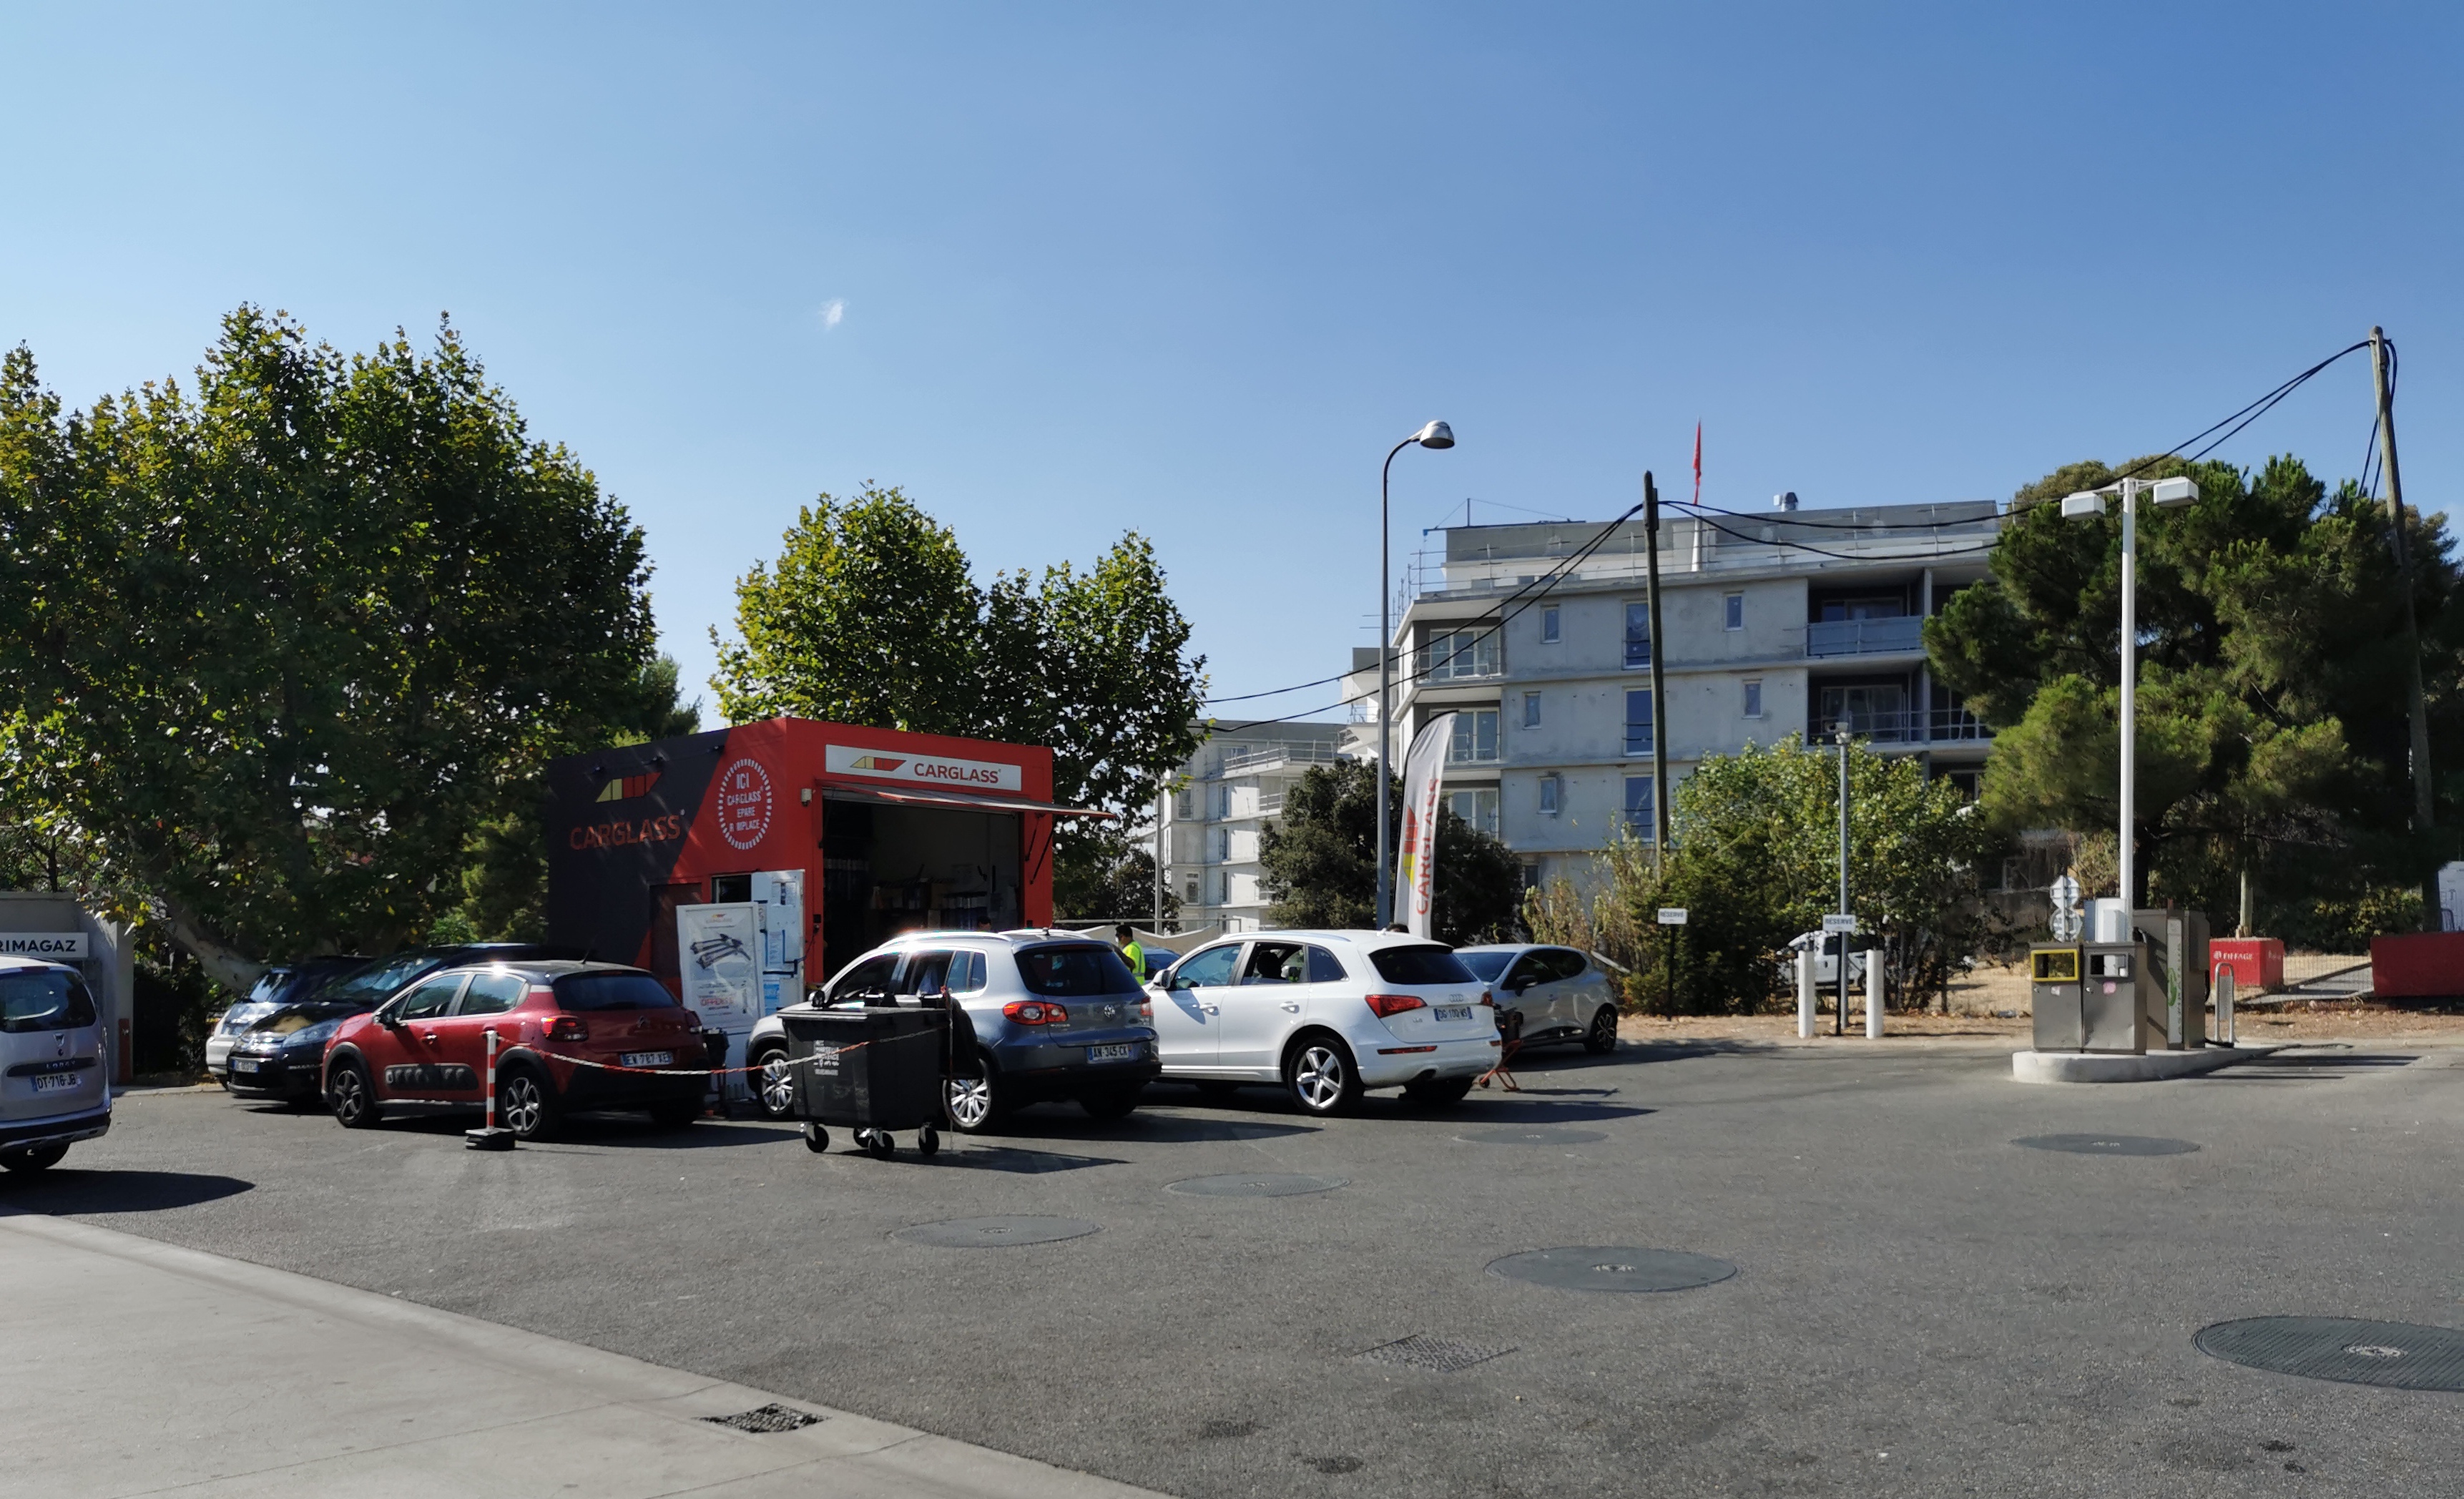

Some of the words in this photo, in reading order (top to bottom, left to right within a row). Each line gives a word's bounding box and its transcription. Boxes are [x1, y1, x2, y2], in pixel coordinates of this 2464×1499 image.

[736, 772, 750, 789] ICI
[914, 763, 998, 784] CARGLASS
[571, 815, 680, 850] CARGLASS
[1416, 778, 1438, 915] CARGLASS
